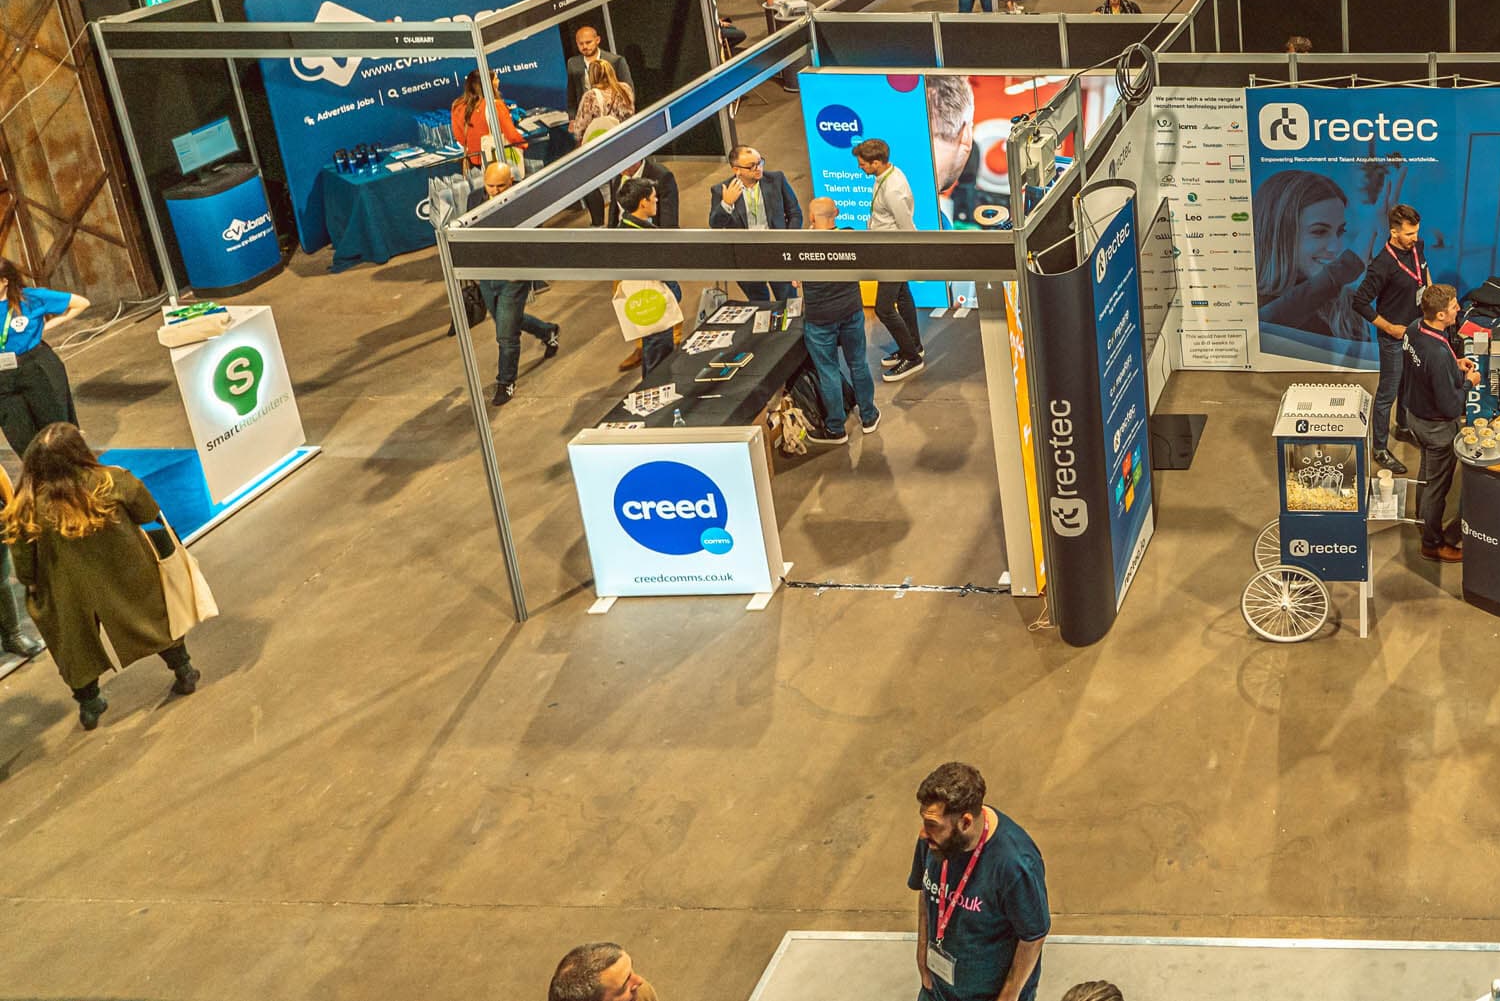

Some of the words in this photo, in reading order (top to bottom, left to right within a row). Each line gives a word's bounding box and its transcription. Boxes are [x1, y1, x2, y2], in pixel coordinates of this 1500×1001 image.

[317, 103, 356, 122] Advertise
[357, 97, 375, 111] jobs
[401, 81, 432, 95] Search
[432, 76, 450, 89] CVs
[513, 60, 538, 71] talent
[819, 119, 858, 132] creed
[1313, 112, 1439, 142] rectec
[822, 170, 863, 180] Employer
[824, 184, 850, 193] Talent
[1185, 213, 1202, 222] Leo
[1104, 222, 1131, 265] rectec
[782, 252, 792, 261] 12
[799, 252, 826, 261] CREED
[827, 252, 857, 261] COMMS
[226, 357, 255, 396] S
[206, 392, 290, 452] SmartRecruiters
[1309, 423, 1344, 432] rectec
[1049, 399, 1079, 497] rectec
[622, 492, 718, 521] creed
[1468, 527, 1499, 546] rectec
[1310, 542, 1358, 554] rectec
[634, 572, 734, 584] creedcomms.co.uk
